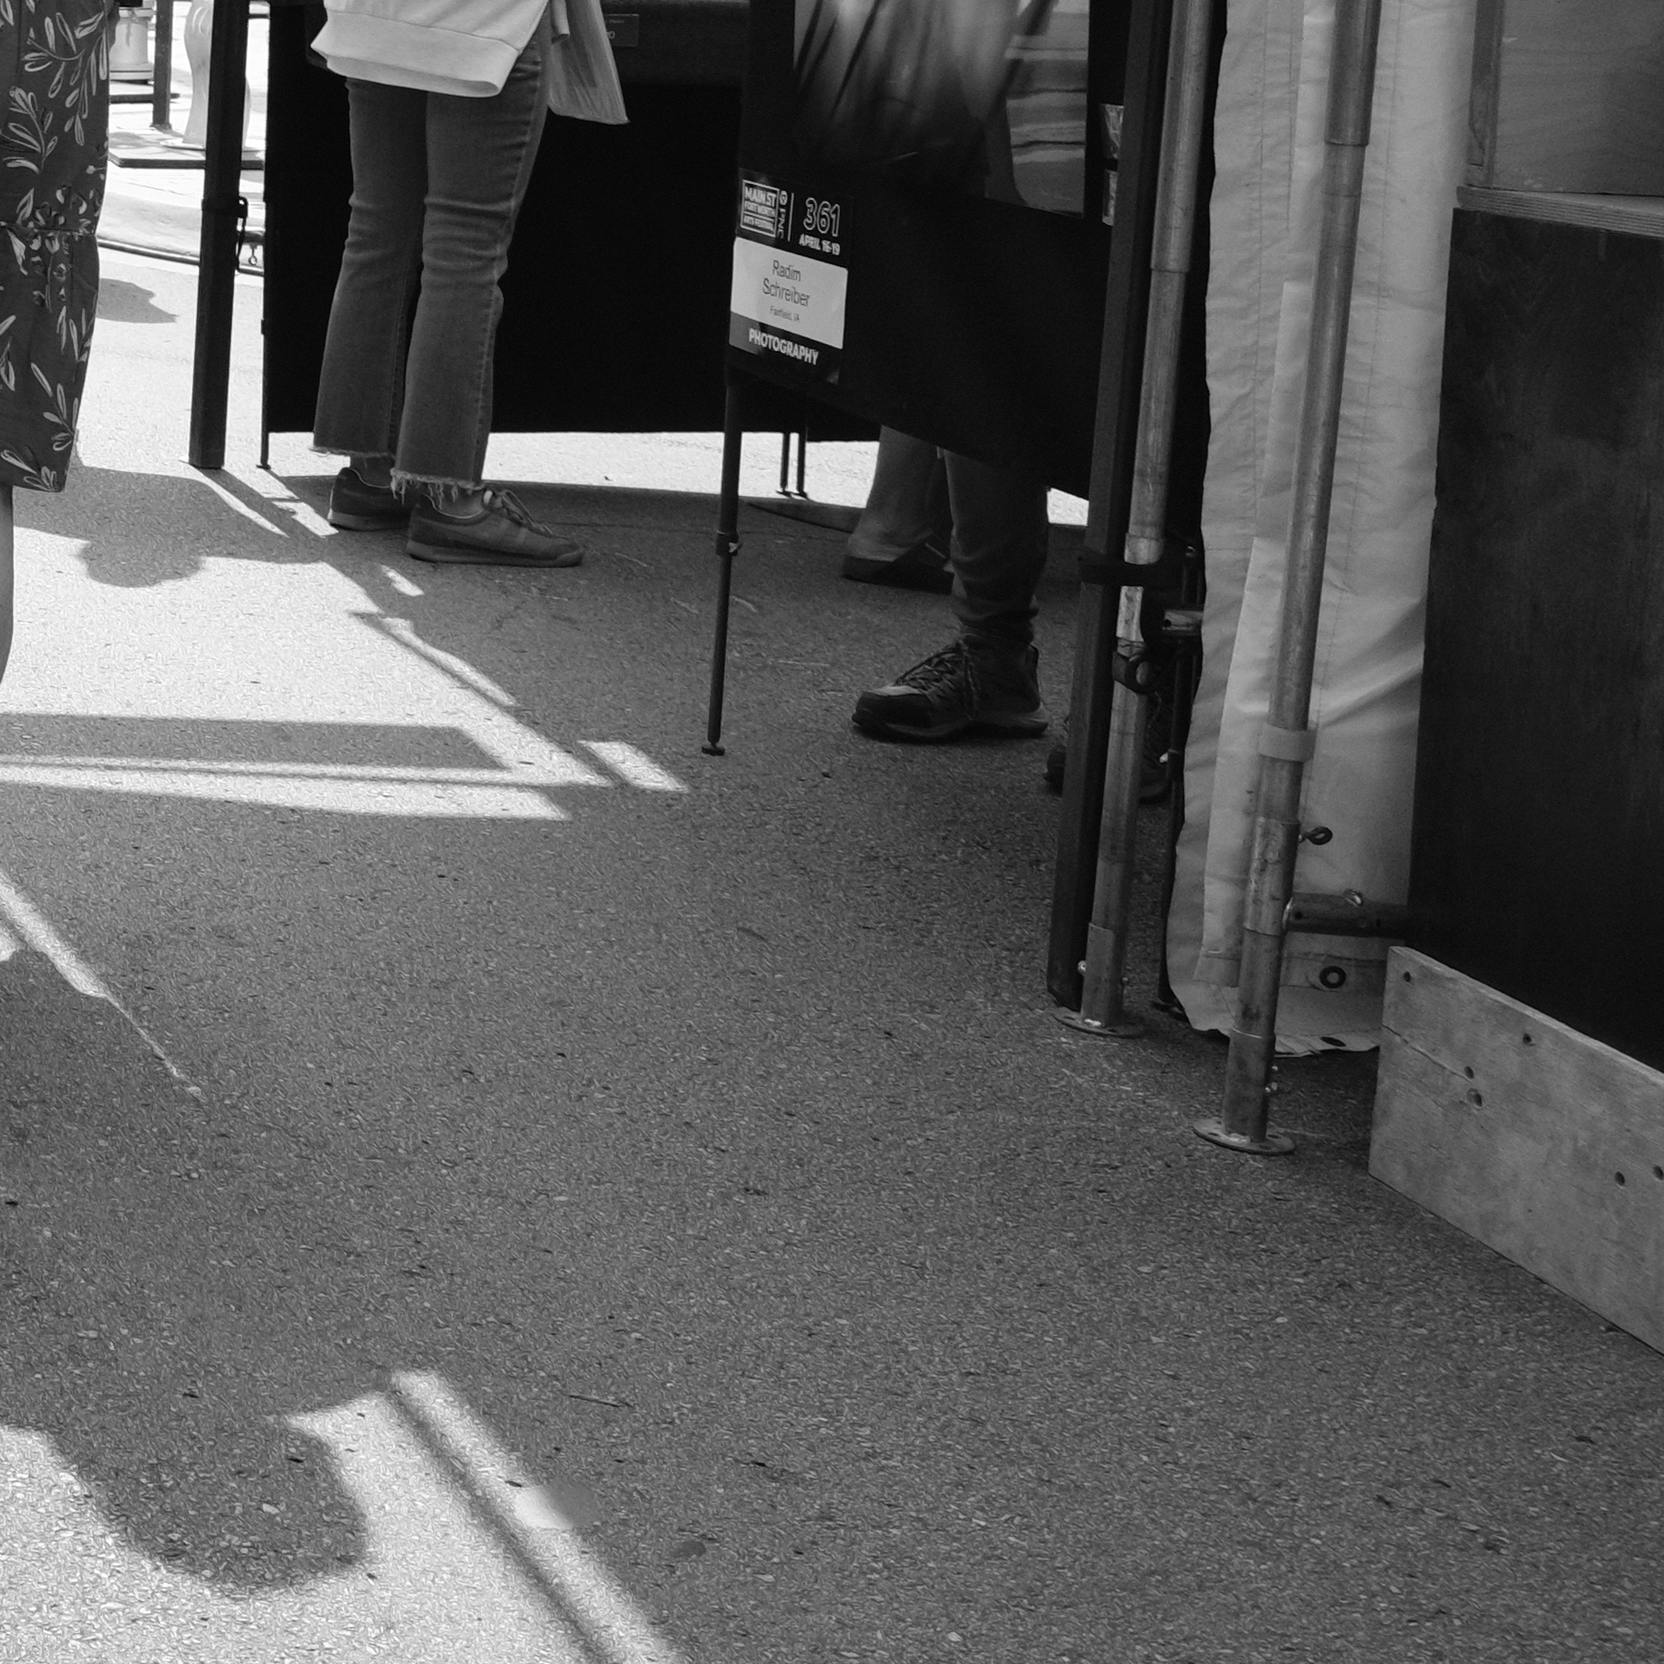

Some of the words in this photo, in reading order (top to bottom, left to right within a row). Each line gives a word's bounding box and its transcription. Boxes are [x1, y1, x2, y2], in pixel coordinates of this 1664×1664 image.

[803, 197, 841, 238] 361
[772, 259, 801, 282] Radim
[762, 278, 810, 306] Schreiber
[748, 328, 819, 365] PHOTOGRAPHY
